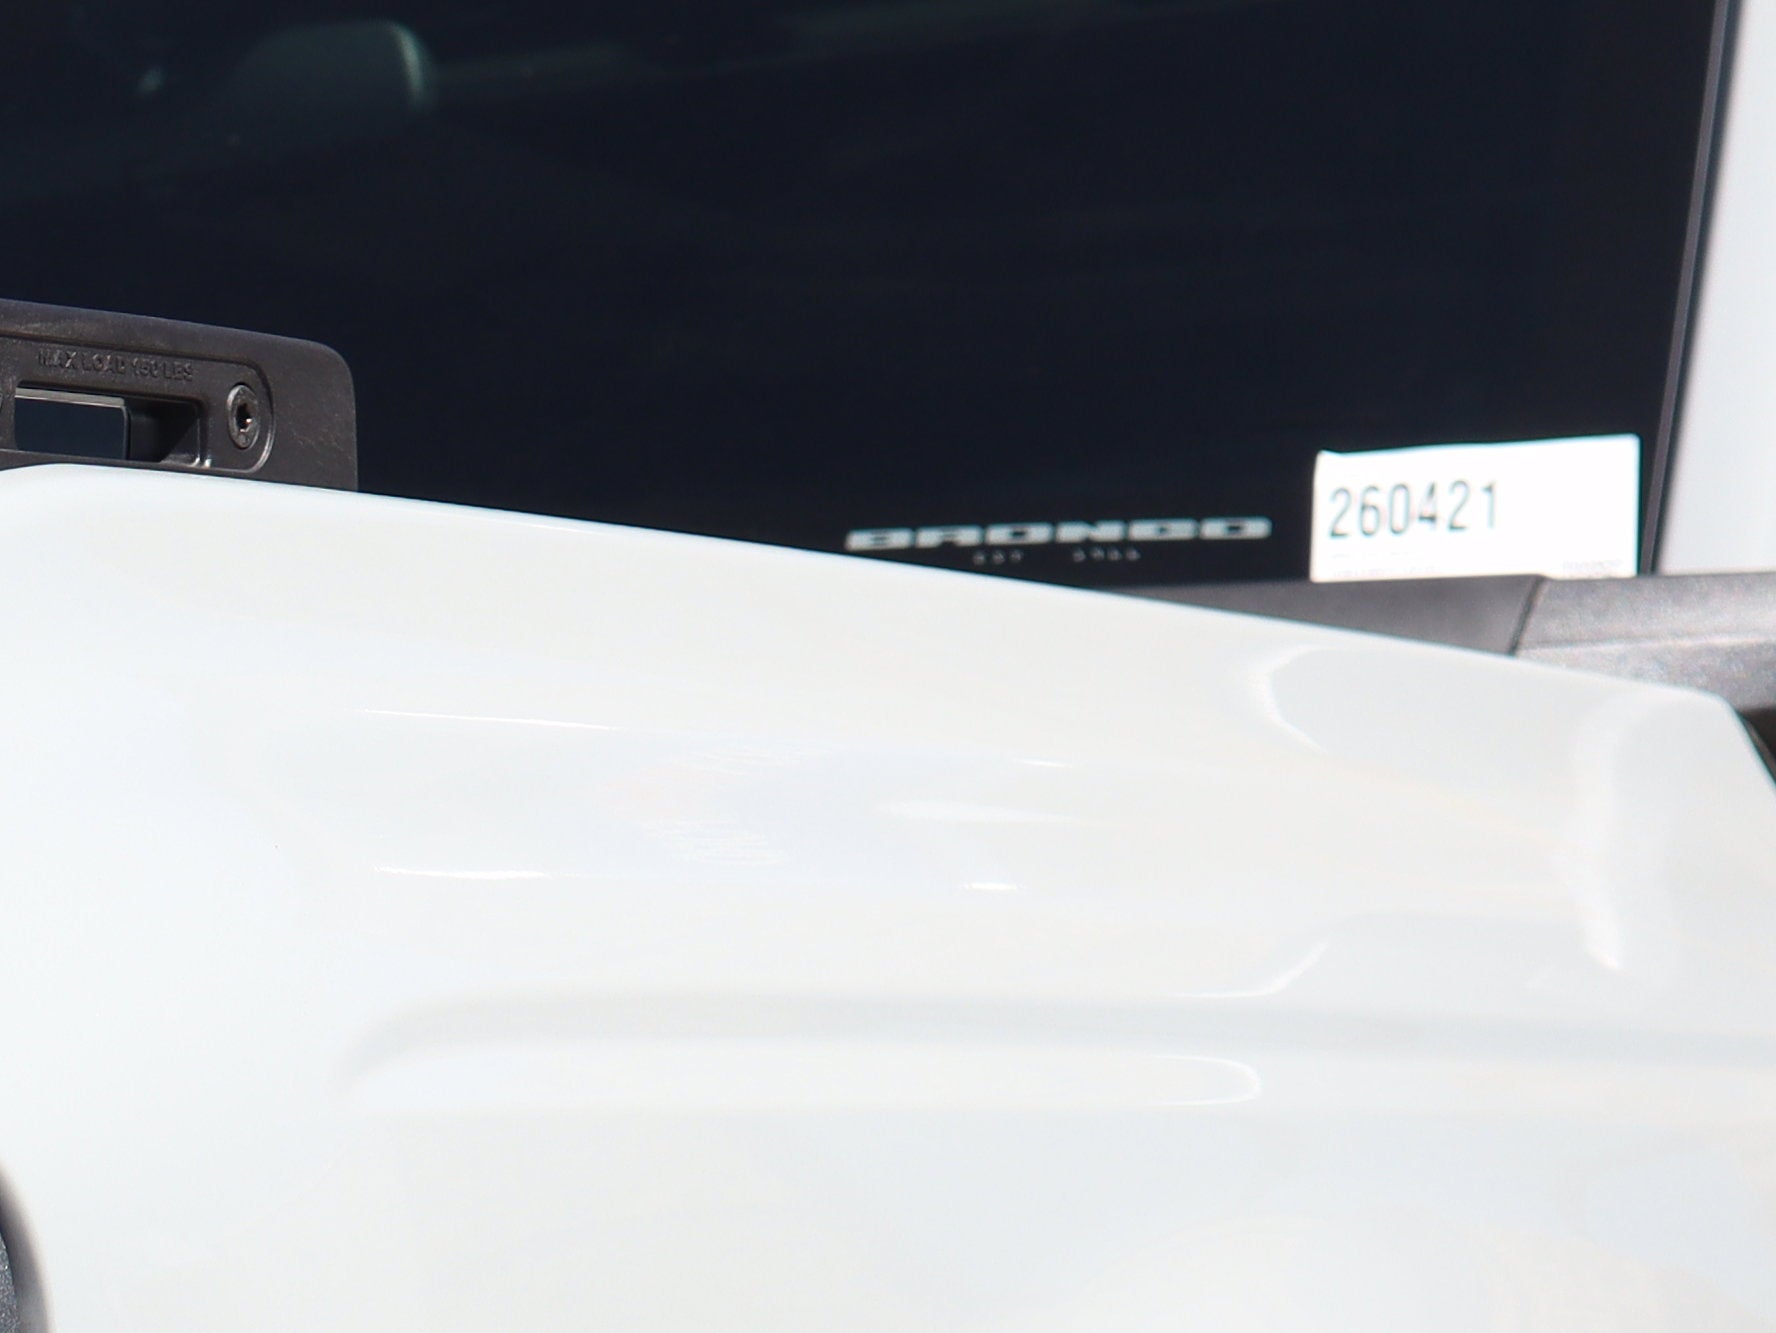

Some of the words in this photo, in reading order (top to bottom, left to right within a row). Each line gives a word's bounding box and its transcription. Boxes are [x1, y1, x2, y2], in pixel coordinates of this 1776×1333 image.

[81, 351, 127, 375] LOAD
[1327, 478, 1501, 541] 260421
[844, 515, 1273, 551] BRONCO
